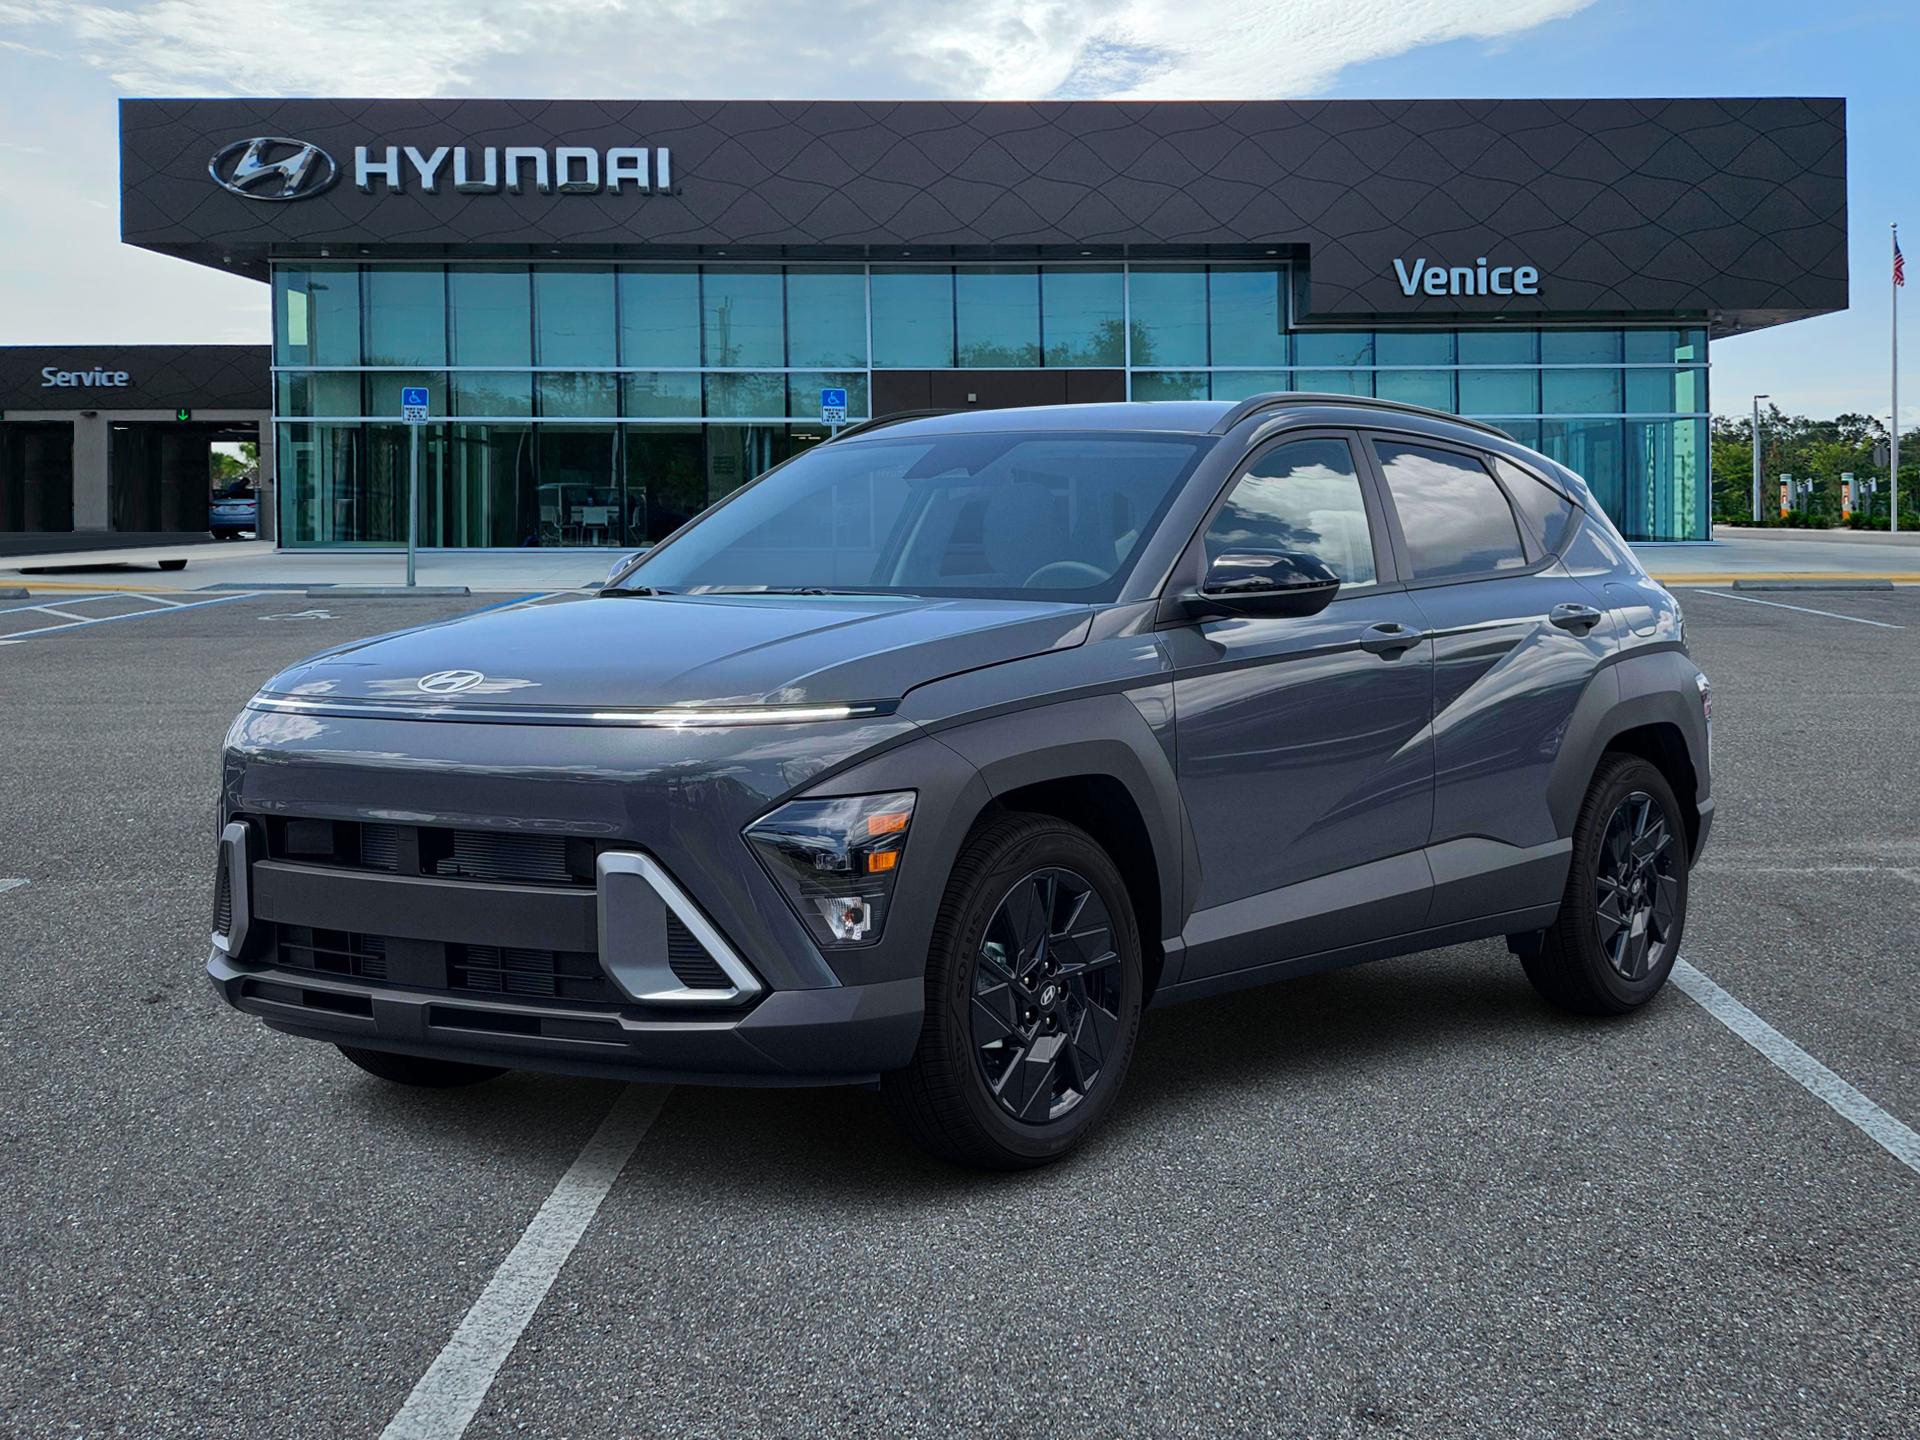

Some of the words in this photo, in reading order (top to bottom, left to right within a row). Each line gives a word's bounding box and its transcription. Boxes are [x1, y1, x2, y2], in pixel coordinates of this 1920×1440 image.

[354, 146, 673, 193] HYUNDAI
[1393, 257, 1538, 296] Venice
[41, 366, 130, 387] Service
